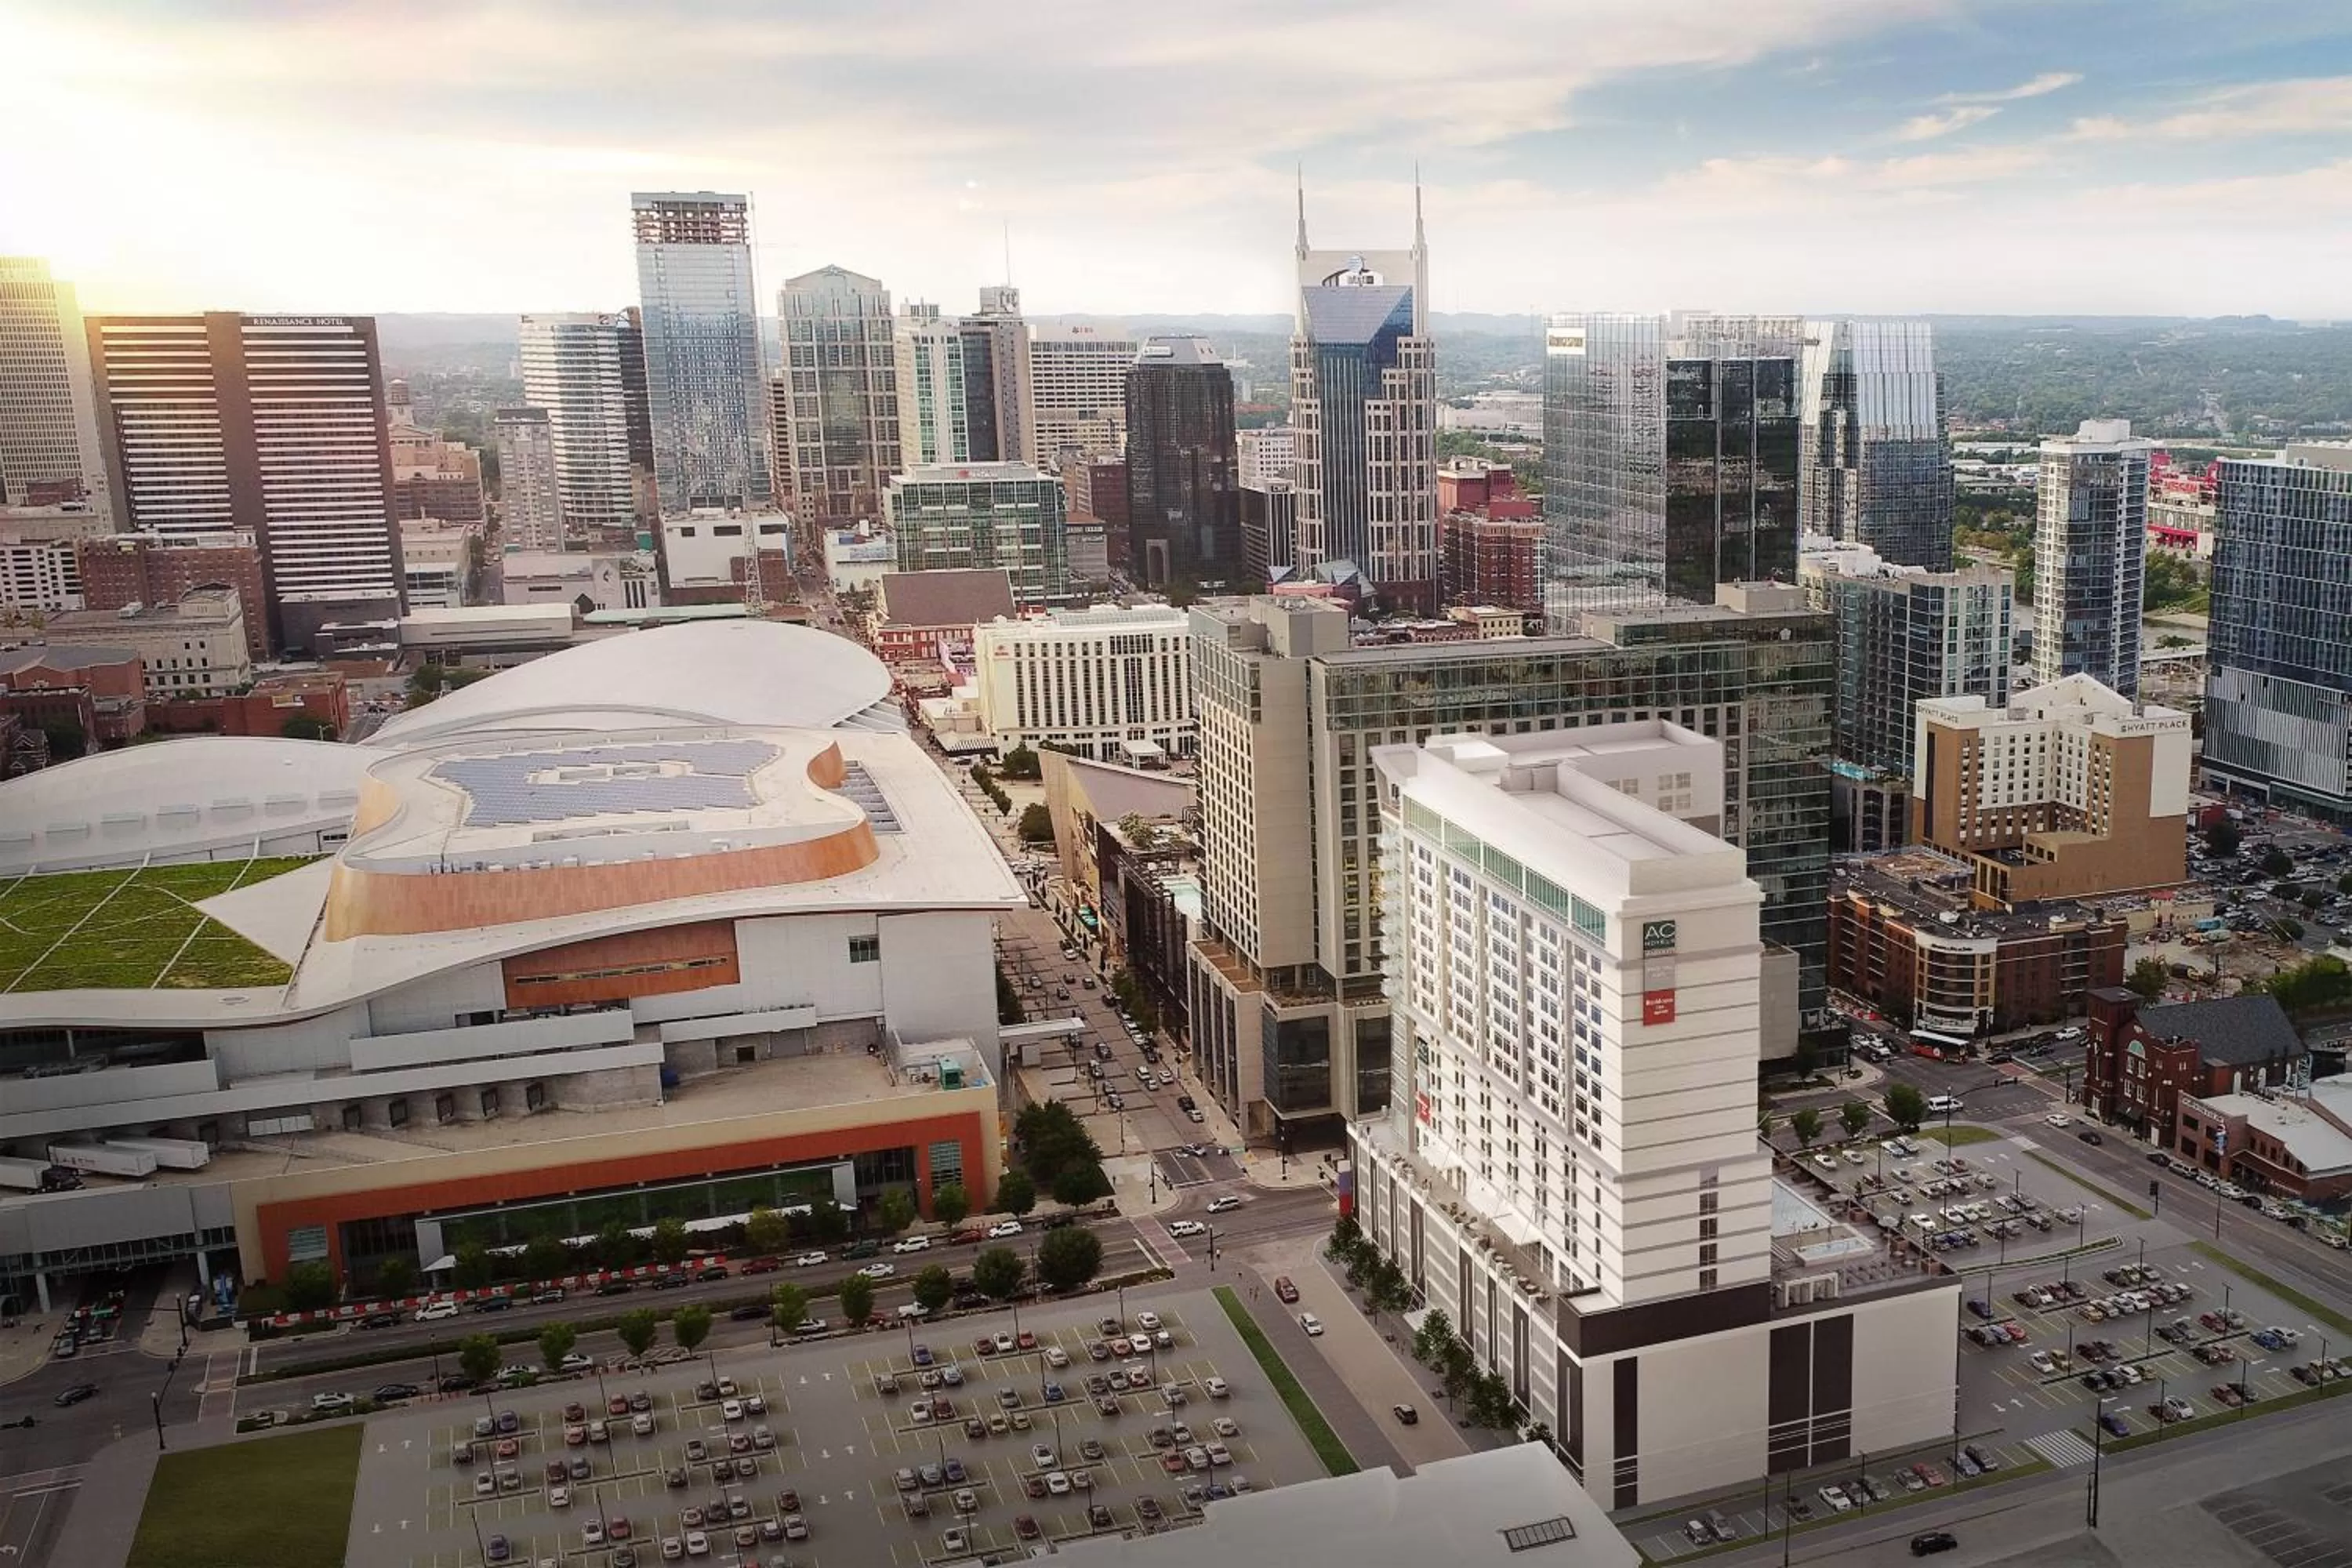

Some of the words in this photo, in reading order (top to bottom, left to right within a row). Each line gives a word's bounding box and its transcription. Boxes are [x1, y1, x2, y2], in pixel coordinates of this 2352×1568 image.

[2127, 722, 2157, 732] HYATT
[2158, 720, 2187, 729] PLACE
[1645, 923, 1675, 939] AC
